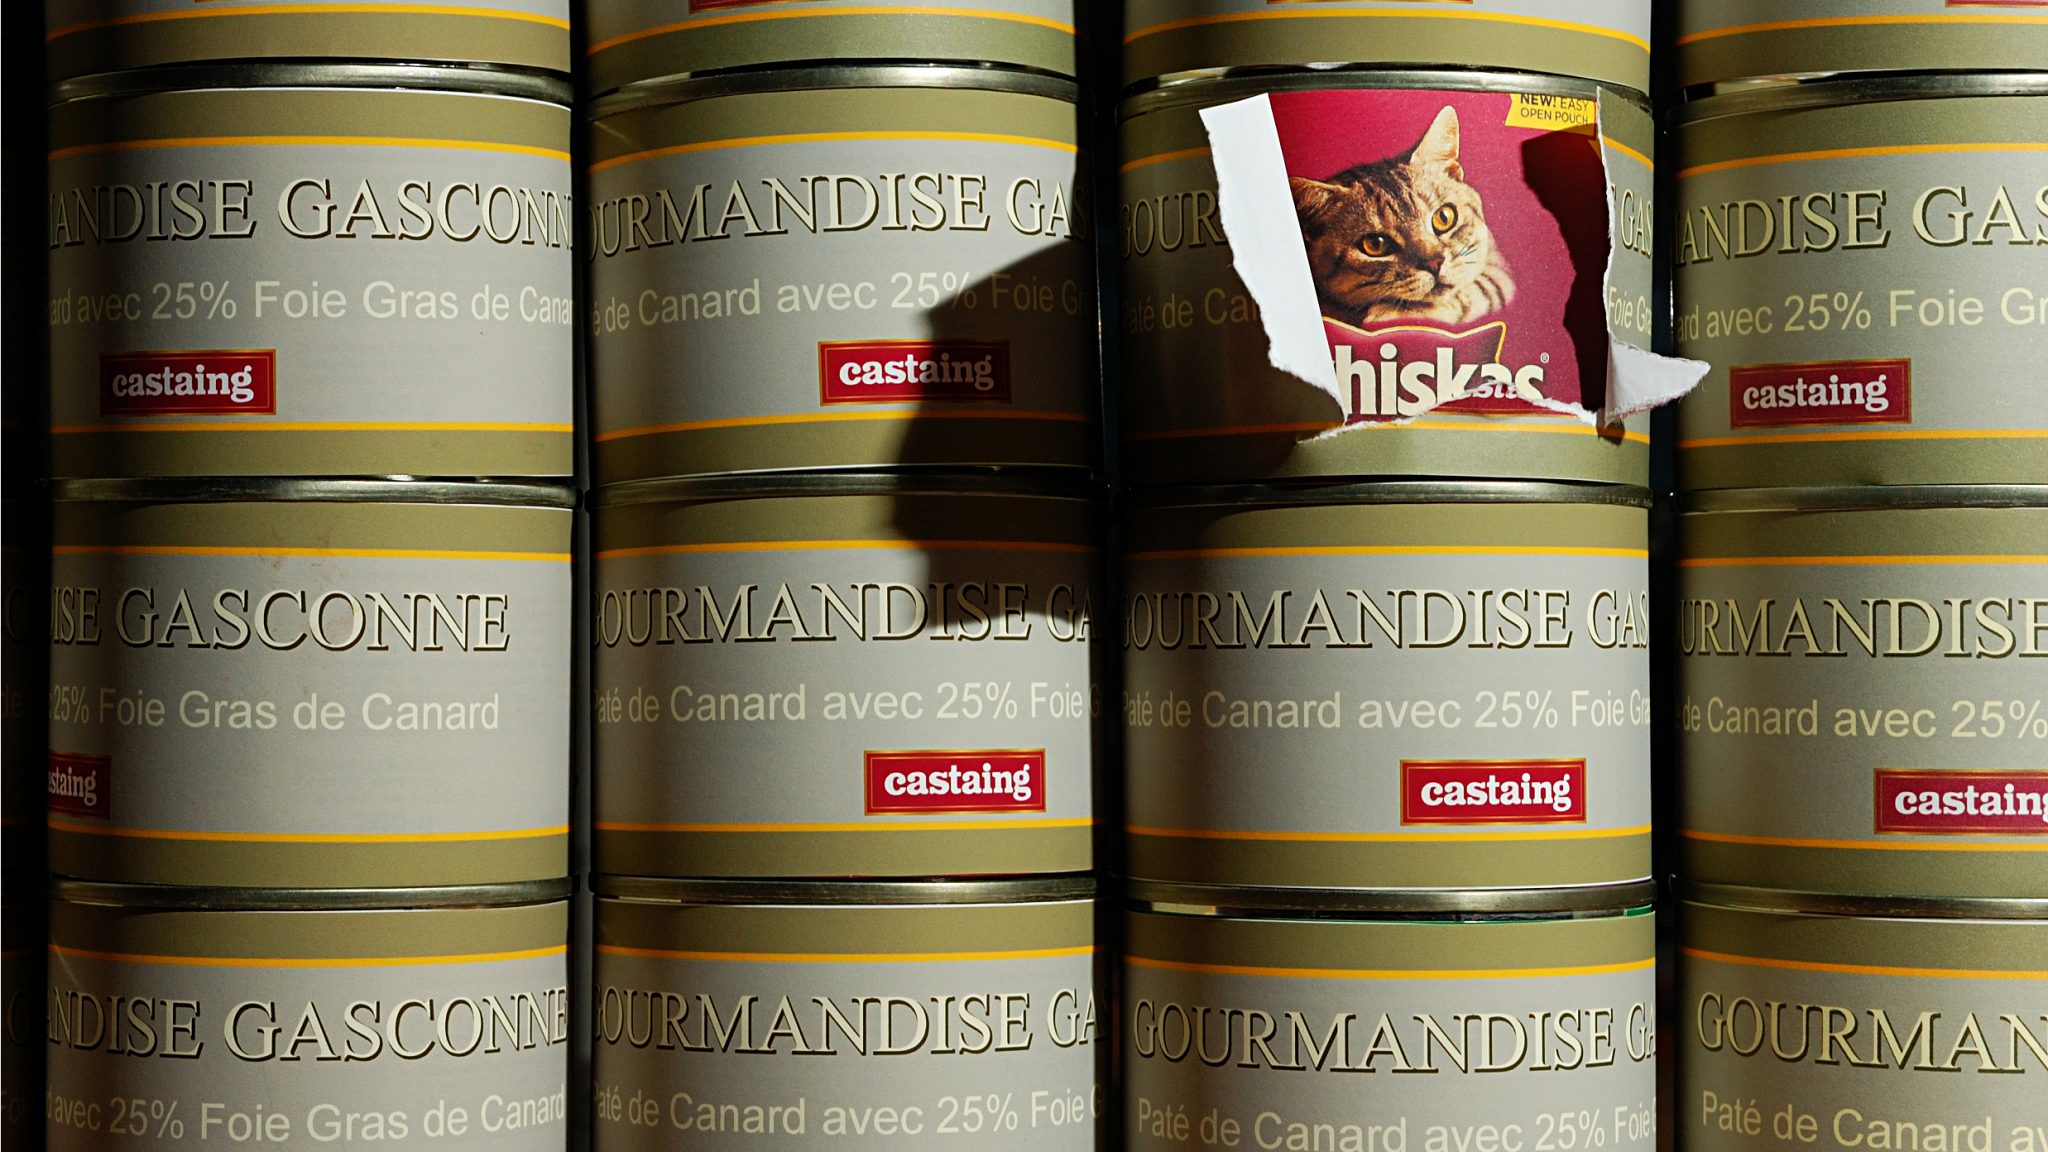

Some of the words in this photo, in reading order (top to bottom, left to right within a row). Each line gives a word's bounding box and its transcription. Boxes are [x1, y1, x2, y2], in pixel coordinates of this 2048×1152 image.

[1520, 93, 1557, 108] NEW!
[1560, 96, 1589, 112] EASY
[1520, 107, 1553, 121] OPEN
[1555, 111, 1589, 125] POUCH
[78, 290, 141, 324] avec
[151, 280, 237, 321] 25%
[255, 280, 347, 320] Foie
[364, 280, 459, 321] Gras
[471, 284, 510, 322] de
[605, 297, 630, 334] de
[639, 278, 761, 327] Canard
[777, 280, 877, 313] avec
[890, 272, 978, 311] 25%
[992, 272, 1055, 313] Foie
[1162, 293, 1195, 329] de
[1608, 286, 1633, 329] Foie
[1707, 304, 1773, 339] avec
[1784, 290, 1872, 332] 25%
[1889, 287, 1985, 328] Foie
[112, 364, 255, 404] castaing
[838, 352, 995, 391] castaing
[1332, 343, 1545, 417] hisks
[1743, 374, 1890, 412] castaing
[115, 588, 511, 653] GASCONNE
[53, 685, 89, 725] 25%
[99, 688, 166, 727] Foie
[179, 690, 279, 731] Gras
[292, 692, 347, 731] de
[362, 692, 499, 732] Canard
[629, 687, 659, 723] de
[670, 684, 806, 723] Canard
[822, 690, 924, 721] avec
[936, 682, 1018, 721] 25%
[1031, 682, 1082, 718] Foie
[1160, 691, 1192, 728] de
[1202, 691, 1341, 730] Canard
[1358, 697, 1462, 730] avec
[1474, 691, 1559, 730] 25%
[1571, 690, 1625, 728] Foie
[1683, 695, 1701, 732] de
[1707, 696, 1818, 736] Canard
[1833, 705, 1937, 738] avec
[1951, 699, 2048, 740] 25%
[884, 762, 1032, 801] castaing
[1420, 773, 1572, 812] castaing
[1895, 783, 2048, 823] castain
[224, 985, 568, 1062] GASCONNE
[1134, 998, 1616, 1075] GOURMANDISE
[54, 1094, 102, 1132] avec
[109, 1096, 184, 1140] 25%
[200, 1102, 290, 1142] Foie
[307, 1102, 409, 1143] Gras
[423, 1100, 468, 1136] de
[480, 1084, 566, 1133] Canard
[629, 1088, 659, 1126] de
[670, 1092, 806, 1137] Canard
[822, 1104, 924, 1137] avec
[937, 1095, 1018, 1134] 25%
[1032, 1088, 1084, 1128] Foie
[1138, 1097, 1190, 1142] Paté
[1200, 1108, 1241, 1146] de
[1254, 1111, 1406, 1152] Canard
[1424, 1118, 1523, 1152] avec
[1535, 1107, 1604, 1149] 25%
[1615, 1103, 1649, 1144] Foie
[1702, 1089, 1763, 1136] Paté
[1773, 1103, 1819, 1143] de
[1832, 1107, 1992, 1152] Canard
